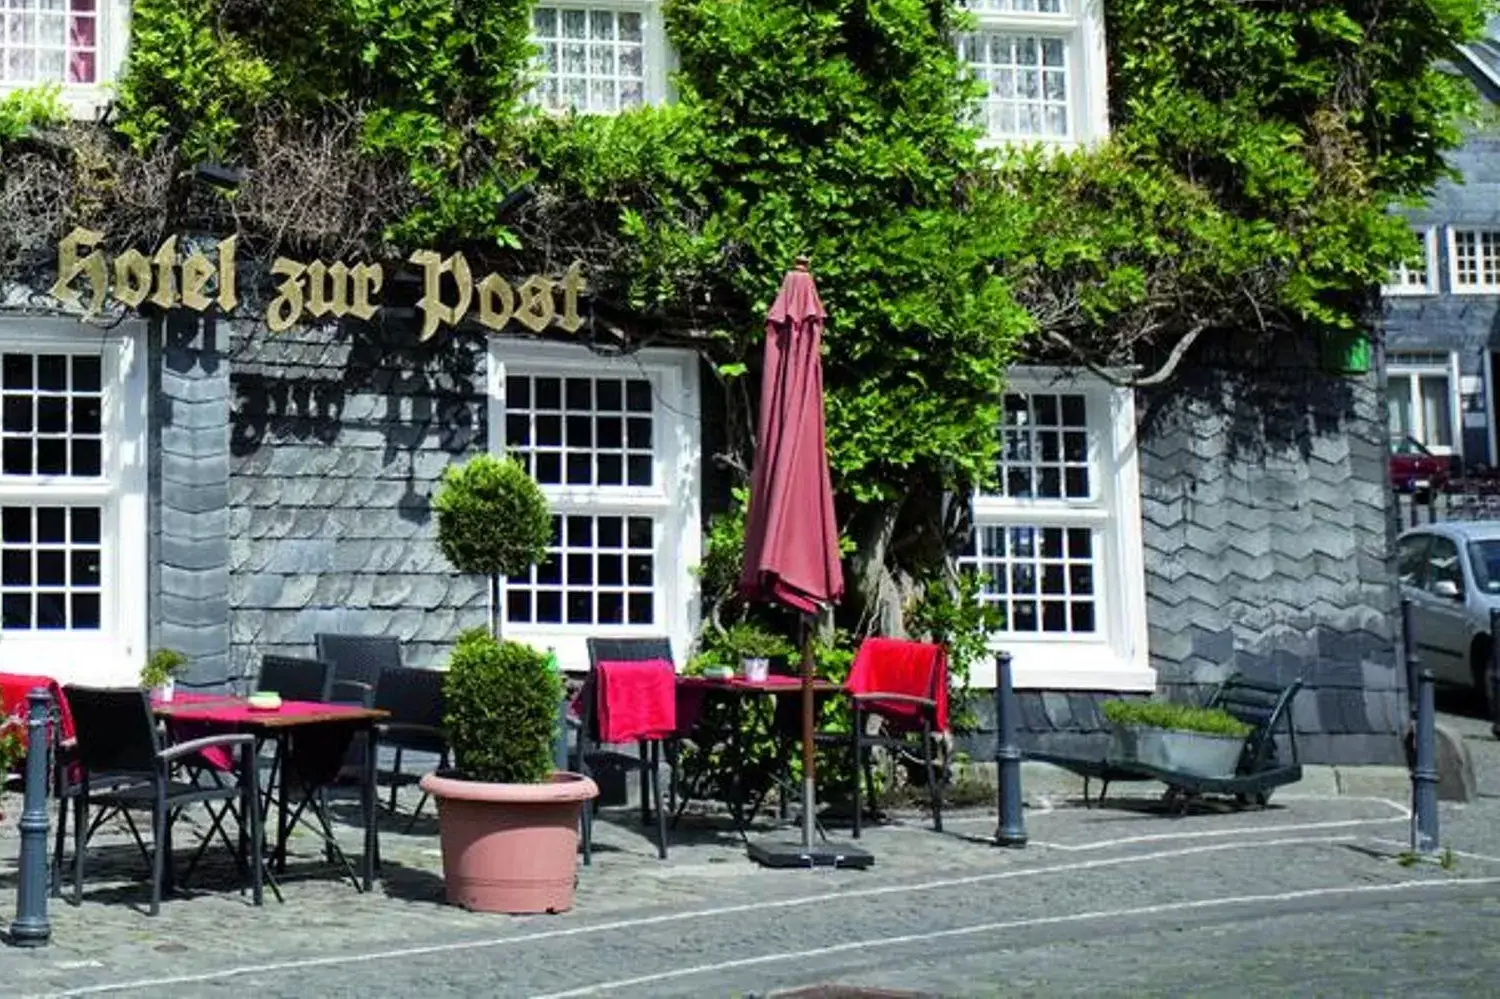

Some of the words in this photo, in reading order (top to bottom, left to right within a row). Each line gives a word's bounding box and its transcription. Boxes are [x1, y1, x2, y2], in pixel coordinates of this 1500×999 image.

[51, 226, 238, 323] Hotel
[266, 255, 383, 332] zur
[409, 248, 587, 341] Post
